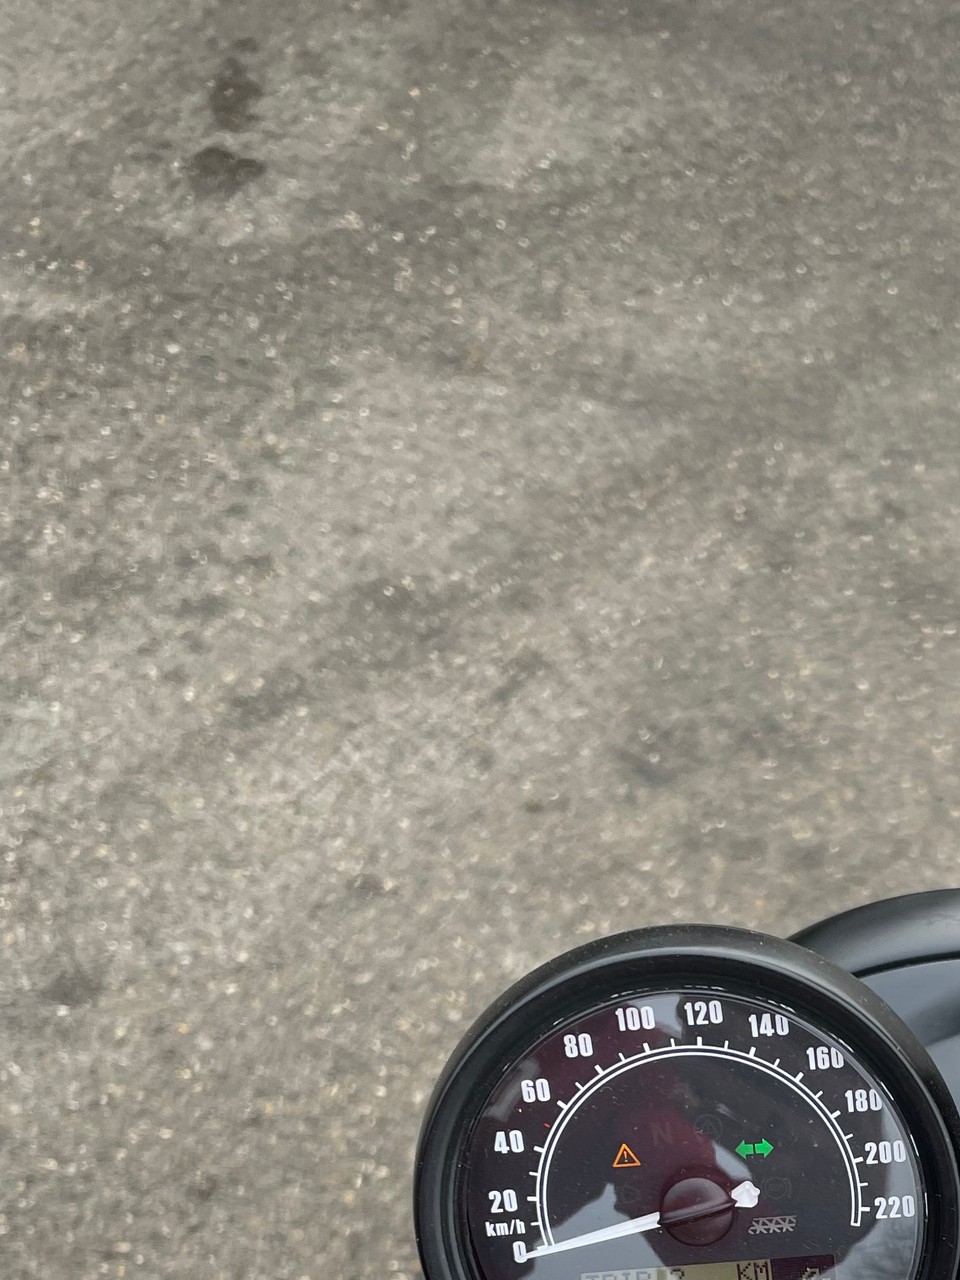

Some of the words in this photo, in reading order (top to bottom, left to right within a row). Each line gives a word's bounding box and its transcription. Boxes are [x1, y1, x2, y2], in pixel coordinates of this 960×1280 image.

[615, 1006, 656, 1032] 100
[684, 1000, 723, 1026] 120
[748, 1014, 790, 1037] 140
[563, 1033, 594, 1058] 80
[806, 1046, 845, 1070] 160
[521, 1078, 551, 1103] 60
[844, 1088, 883, 1112] 180
[493, 1130, 525, 1154] 40
[864, 1141, 906, 1164] 200
[488, 1190, 518, 1213] 20
[874, 1196, 916, 1220] 220
[485, 1218, 526, 1237] km/h
[512, 1240, 528, 1263] 0
